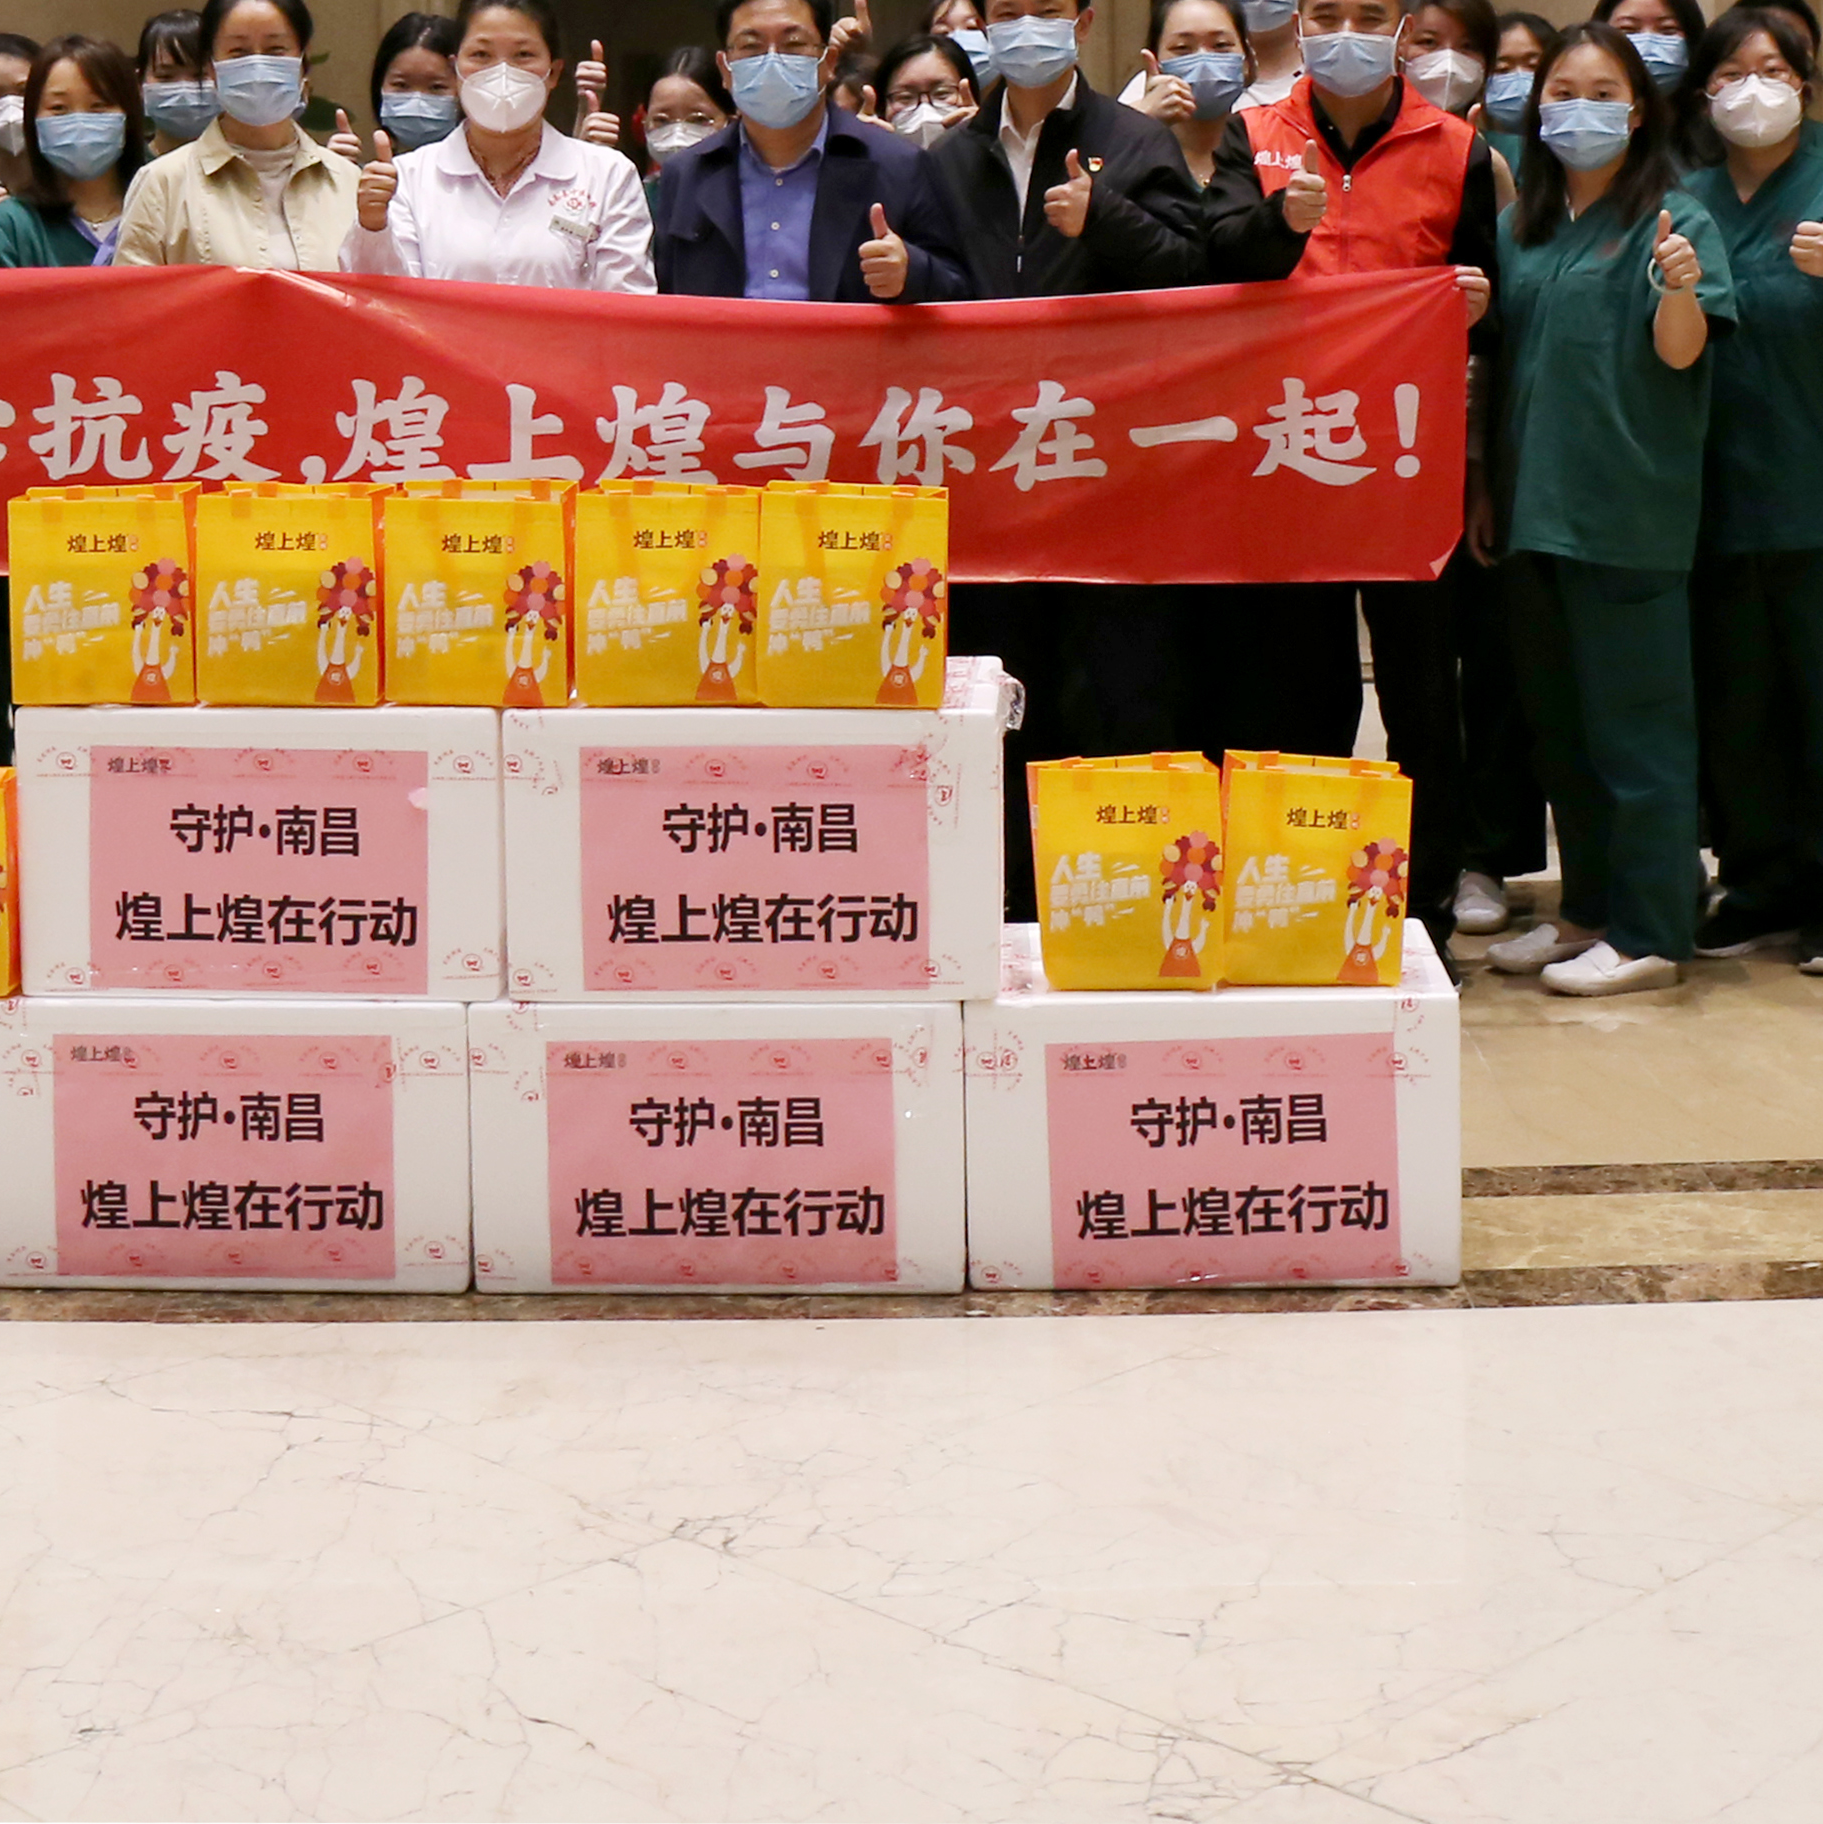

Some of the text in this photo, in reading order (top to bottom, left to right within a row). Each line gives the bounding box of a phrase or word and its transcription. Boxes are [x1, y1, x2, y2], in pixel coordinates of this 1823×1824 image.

[67, 533, 128, 553] 煌上煌
[255, 531, 316, 552] 煌上煌
[441, 534, 504, 554] 煌上煌
[633, 528, 695, 550] 煌上煌
[818, 529, 881, 552] 煌上煌
[170, 803, 360, 857] 守护·南昌
[662, 801, 859, 854] 守护·南昌
[1096, 804, 1158, 825] 煌上煌
[1286, 807, 1348, 830] 煌上煌
[115, 891, 418, 947] 煌上煌在行动
[607, 892, 919, 944] 煌上煌在行动
[133, 1090, 325, 1143] 守护·南昌
[629, 1096, 825, 1148] 守护·南昌
[1130, 1093, 1328, 1148] 守护·南昌
[80, 1179, 384, 1231] 煌上煌在行动
[574, 1185, 886, 1238] 煌上煌在行动
[1076, 1180, 1390, 1240] 煌上煌在行动
